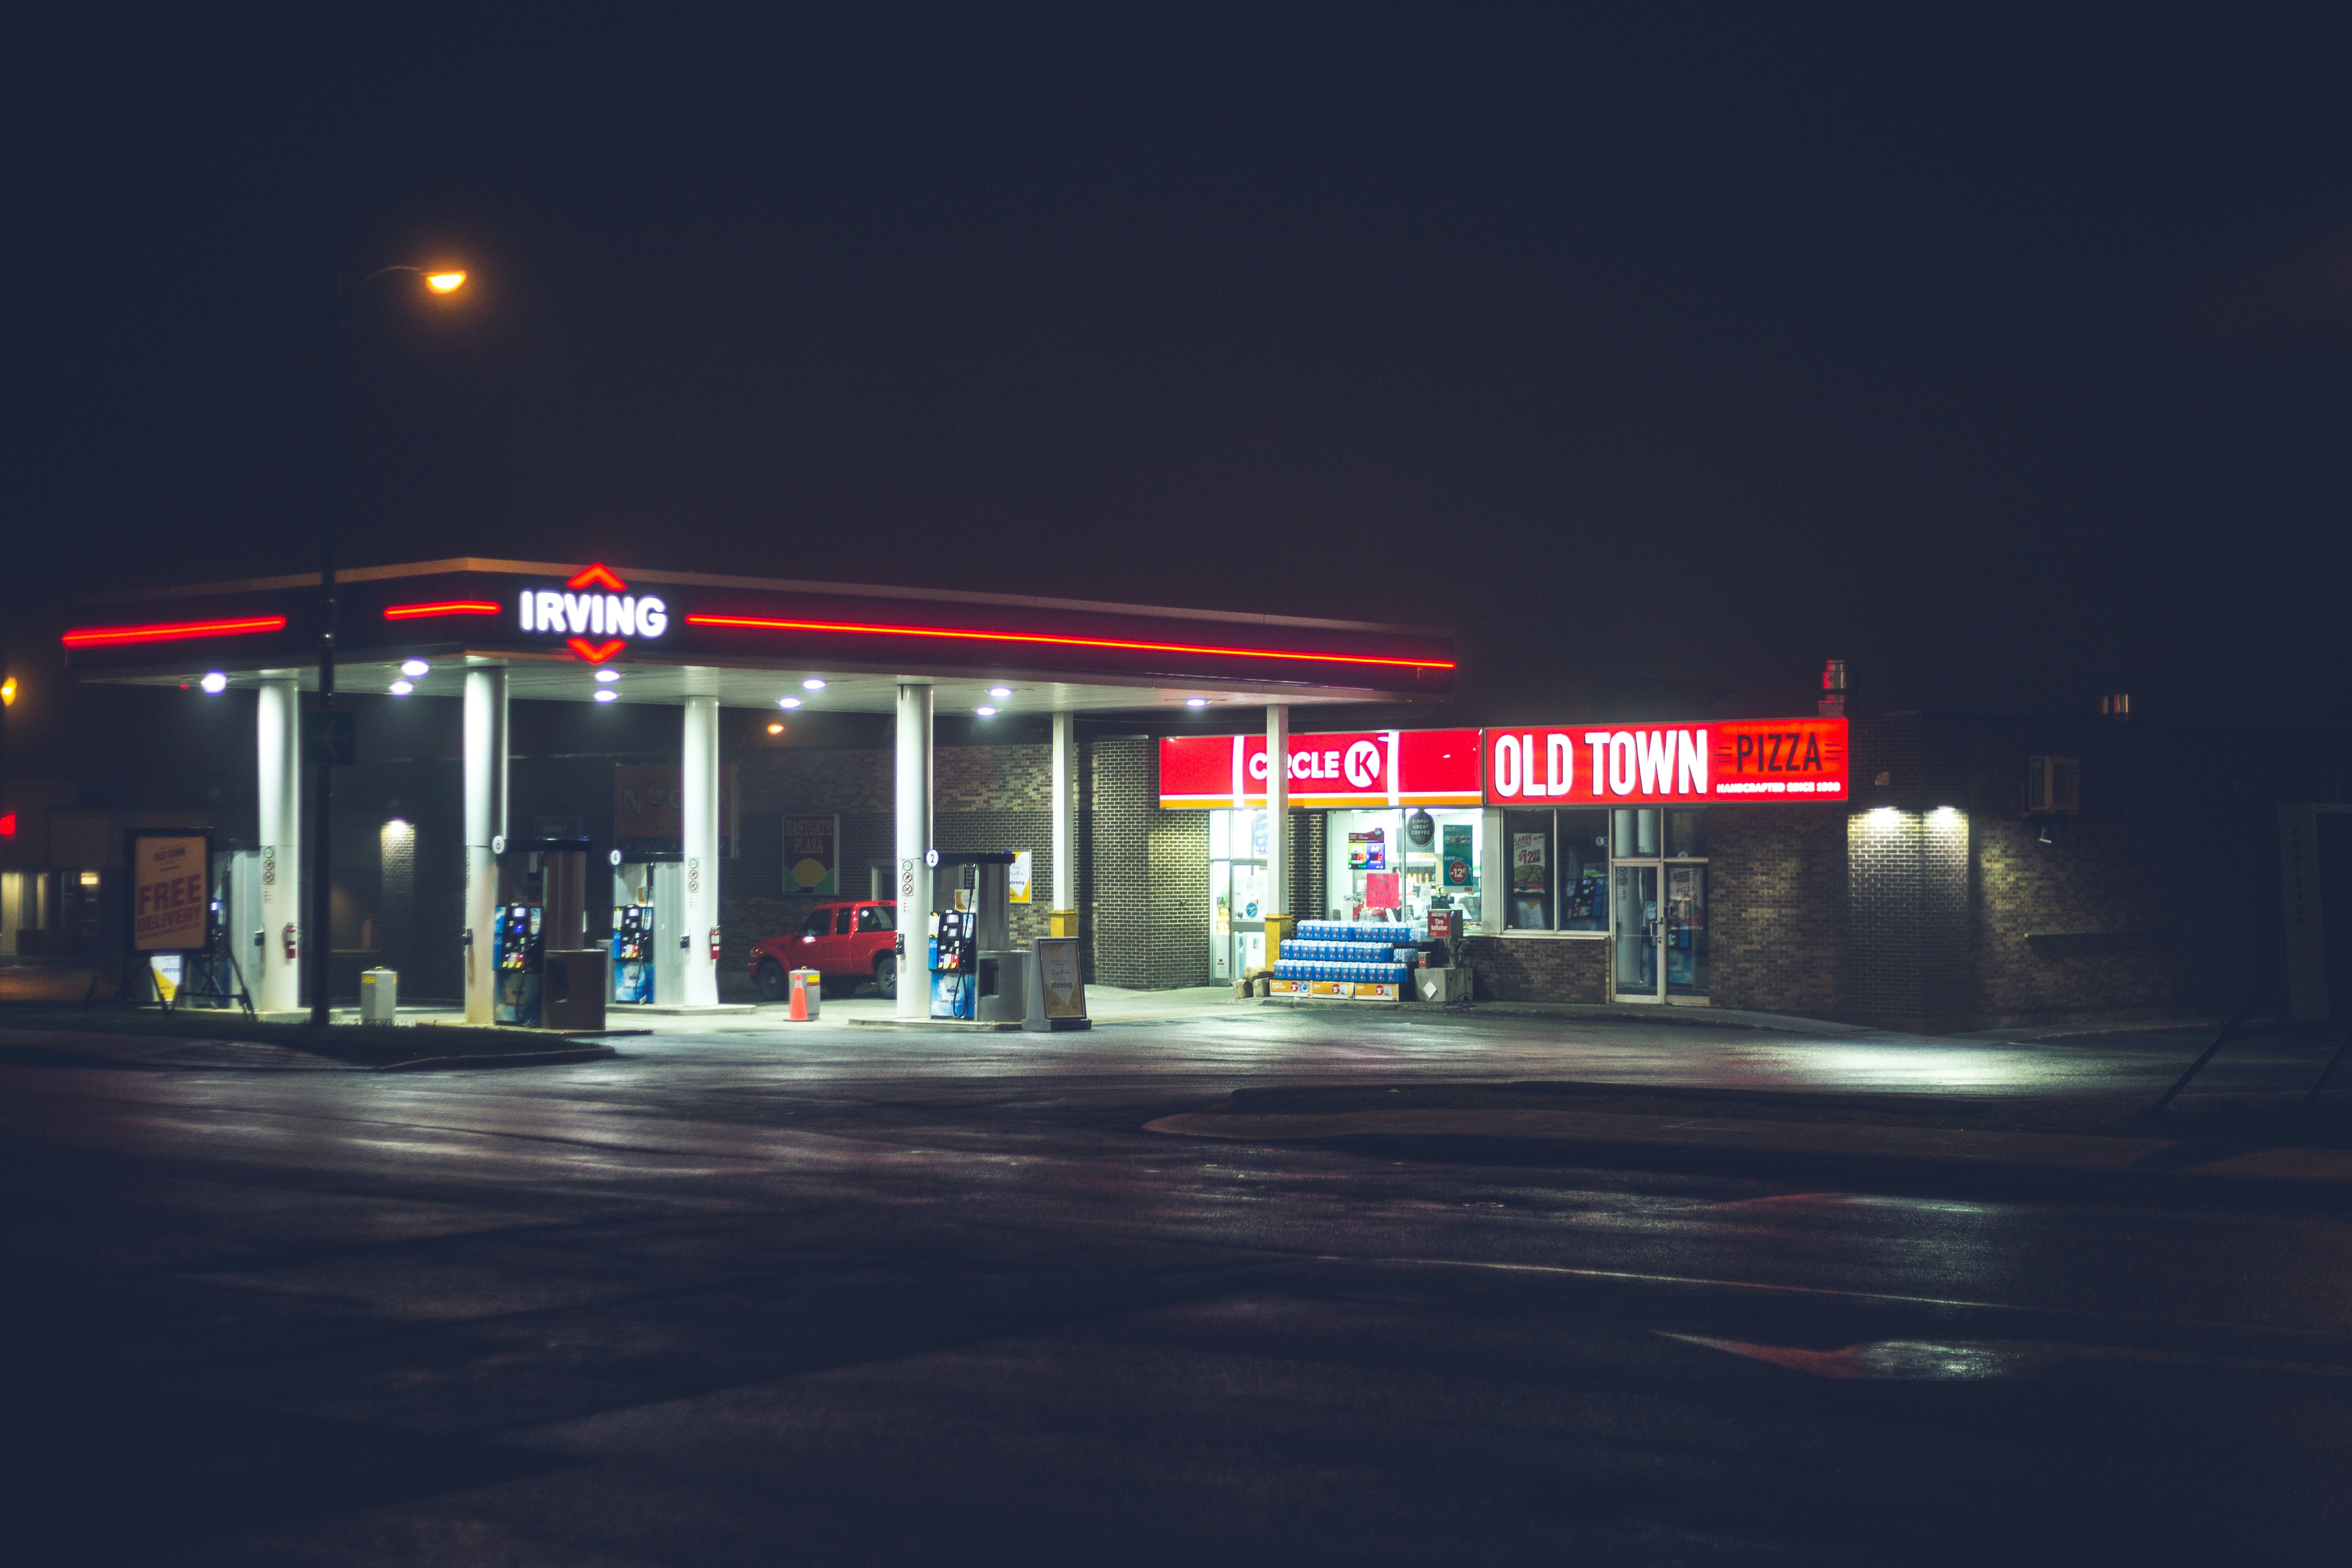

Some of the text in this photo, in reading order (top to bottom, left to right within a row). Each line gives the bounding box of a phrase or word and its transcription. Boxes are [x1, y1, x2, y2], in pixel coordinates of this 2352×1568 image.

[520, 590, 668, 637] IRVING
[1494, 729, 1708, 797] OLD TOWN
[1736, 733, 1822, 772] PIZZA
[1717, 783, 1785, 793] HANDCRAFTED
[1787, 782, 1815, 792] SINCE
[786, 820, 833, 836] EASTGATE
[793, 838, 824, 854] PLAZA
[137, 873, 202, 915] FREE
[138, 905, 202, 933] DELIVERY
